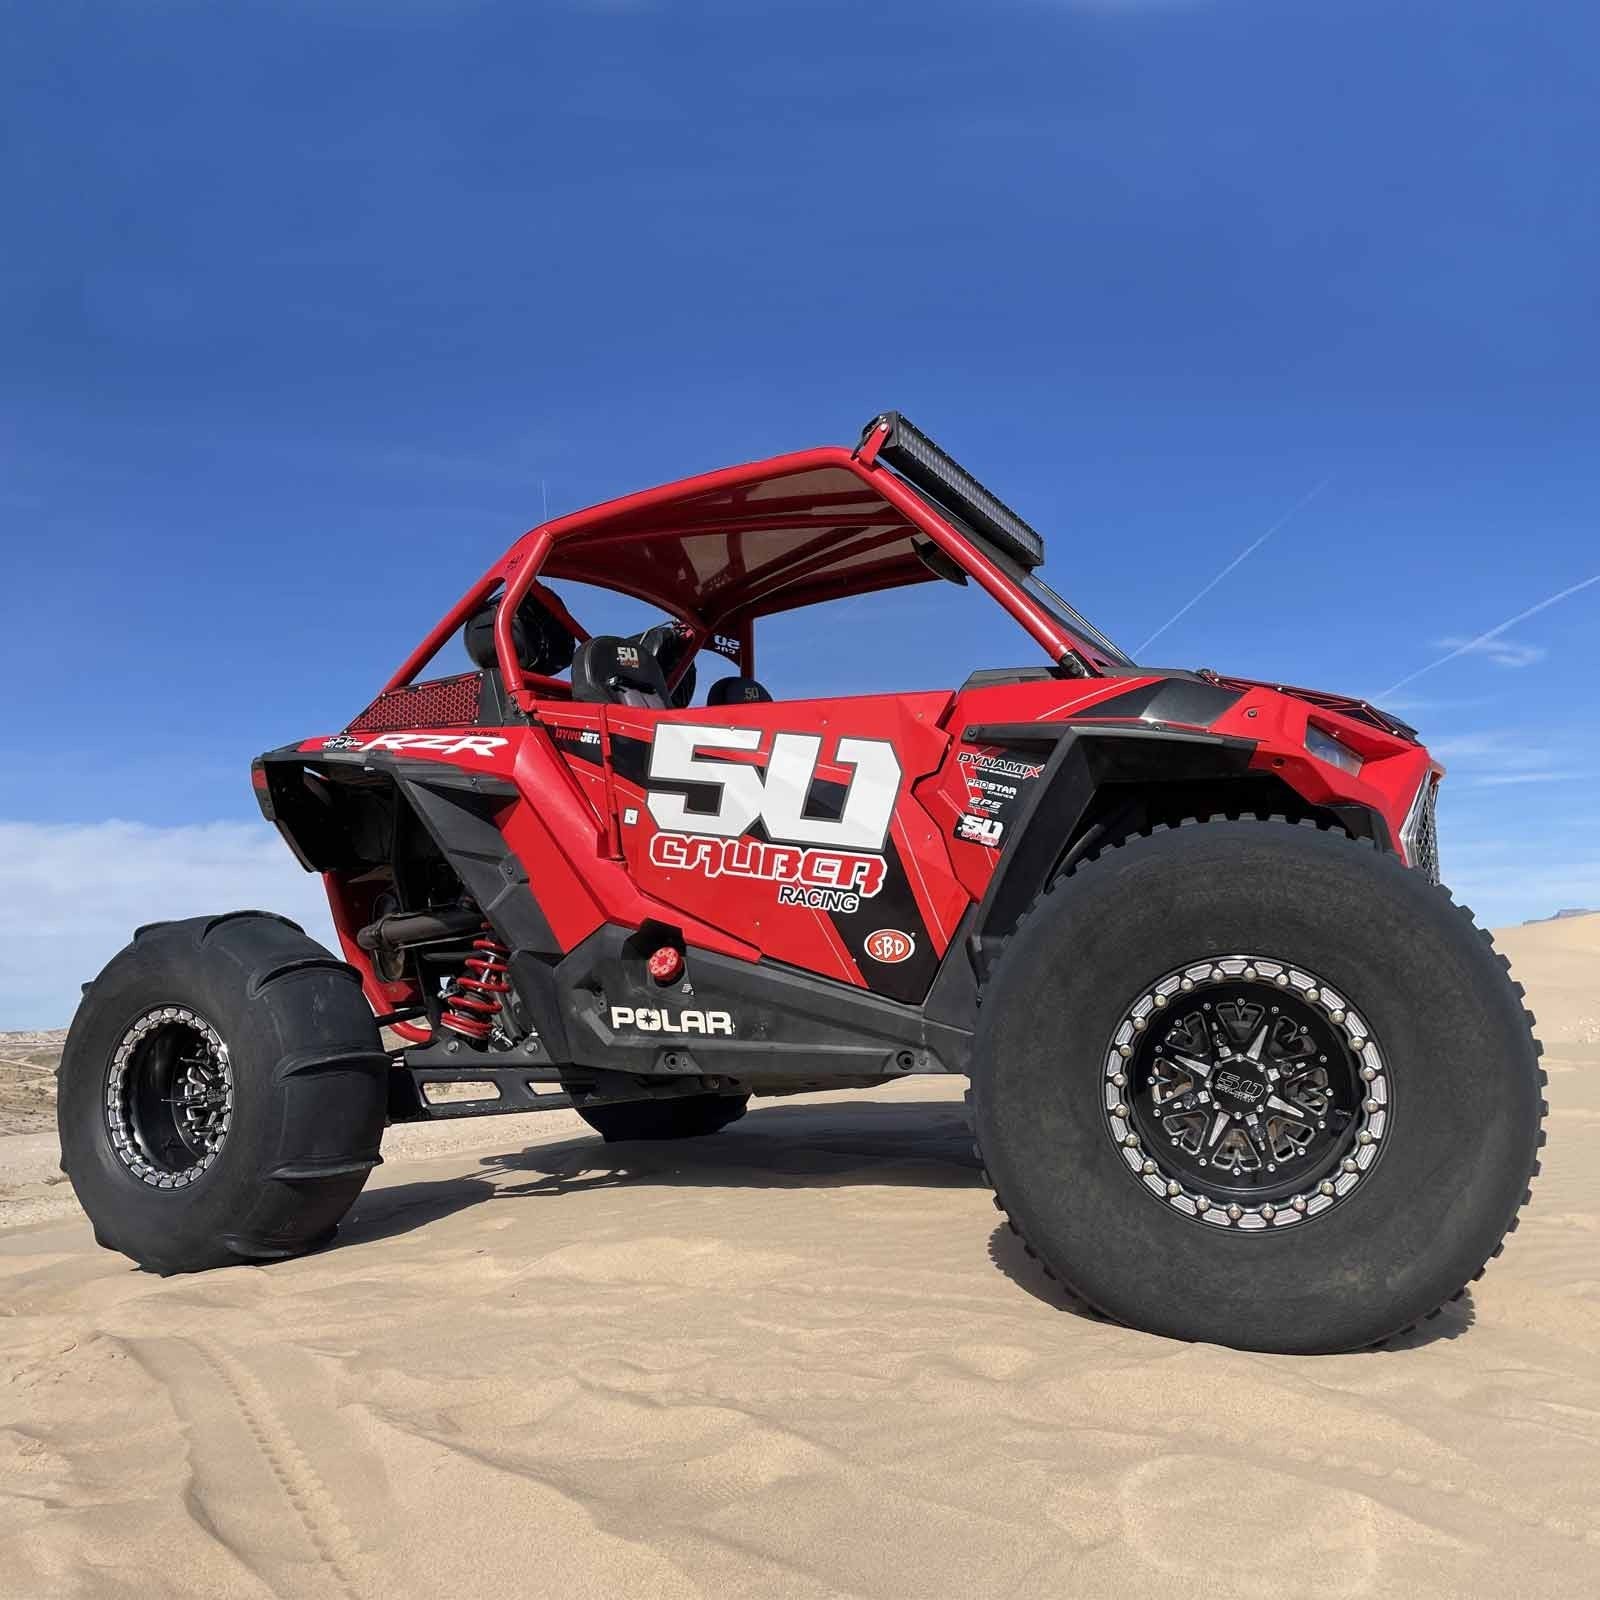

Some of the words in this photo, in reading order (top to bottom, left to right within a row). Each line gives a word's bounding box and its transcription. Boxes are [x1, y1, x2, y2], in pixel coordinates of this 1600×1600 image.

[358, 734, 509, 758] RZR
[957, 752, 1046, 780] DYNAMIX
[645, 721, 902, 851] 50
[966, 778, 1018, 797] PROSTAR
[969, 797, 1003, 810] EPS
[649, 832, 888, 898] CALIBER
[777, 884, 860, 914] RACING
[874, 935, 905, 959] SBD
